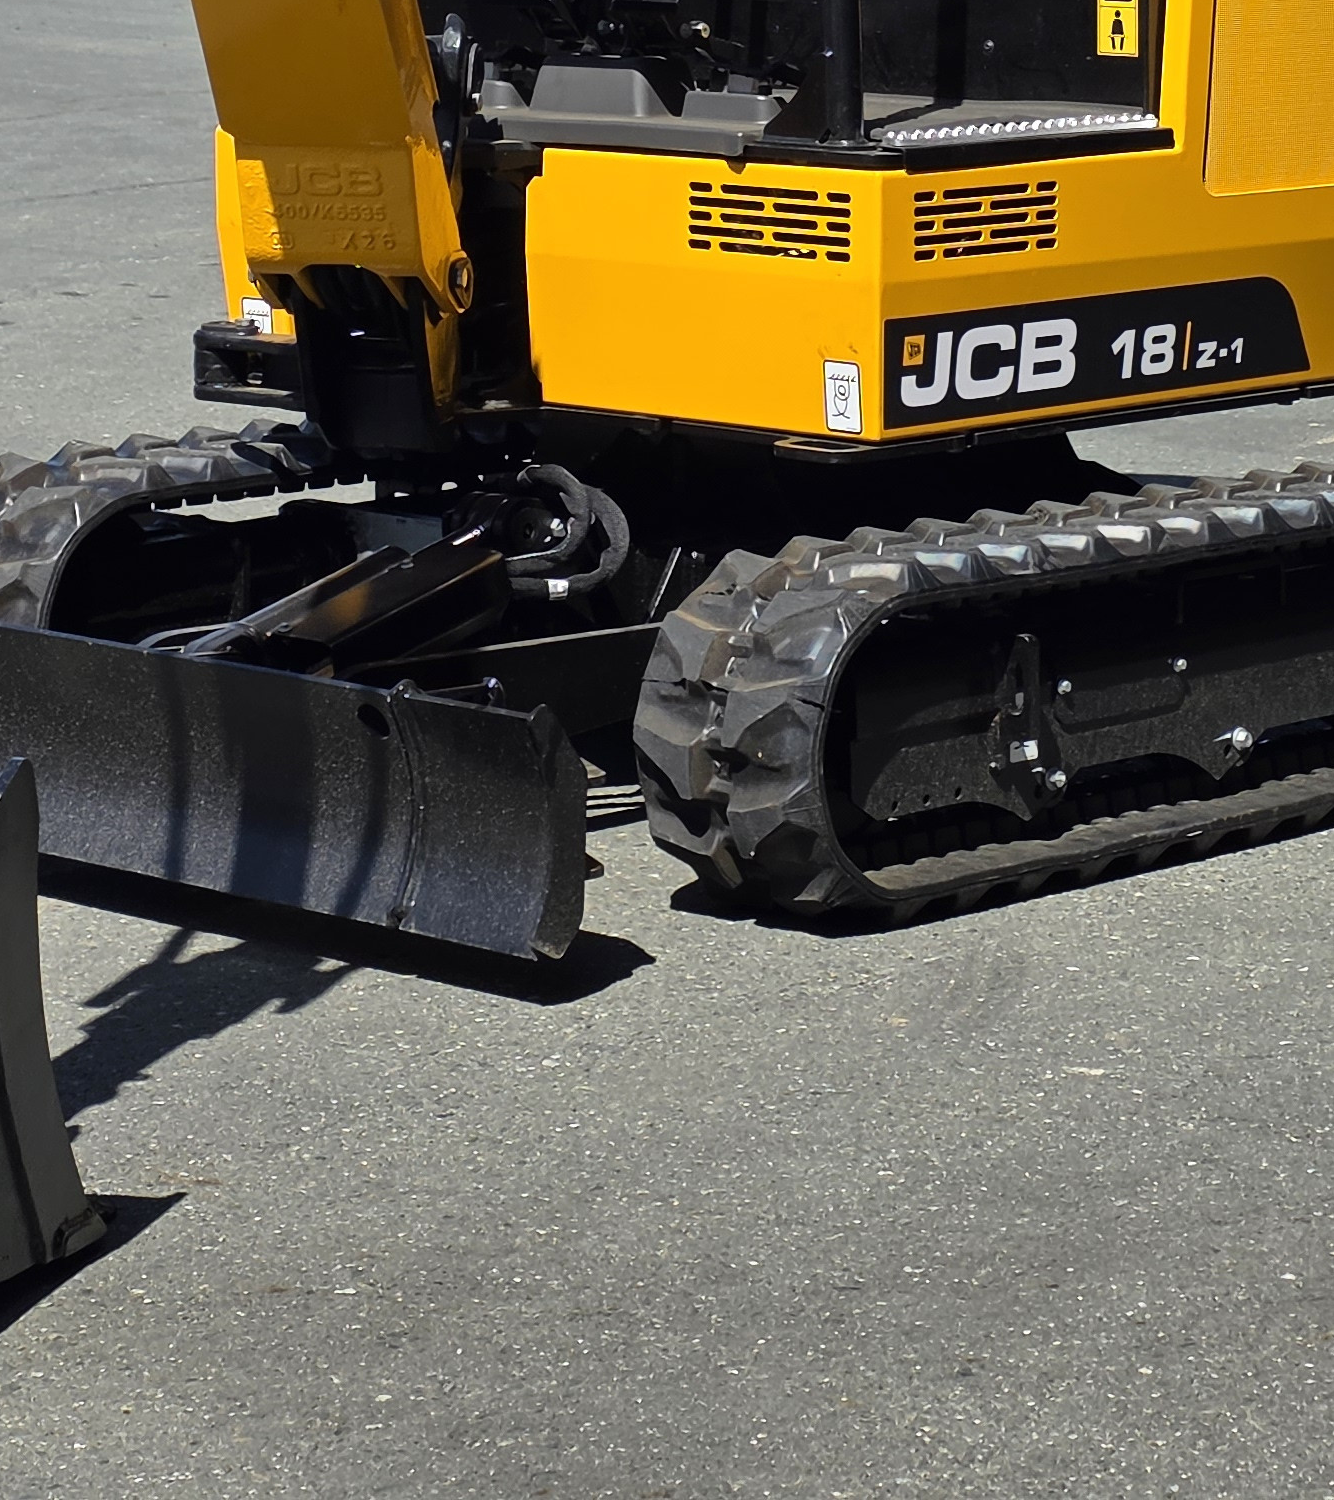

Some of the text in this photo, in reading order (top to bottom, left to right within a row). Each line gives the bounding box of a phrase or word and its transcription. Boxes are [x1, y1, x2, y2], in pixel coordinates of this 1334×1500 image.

[271, 163, 384, 197] JCB
[900, 318, 1078, 408] JCB
[1111, 323, 1177, 379] 18
